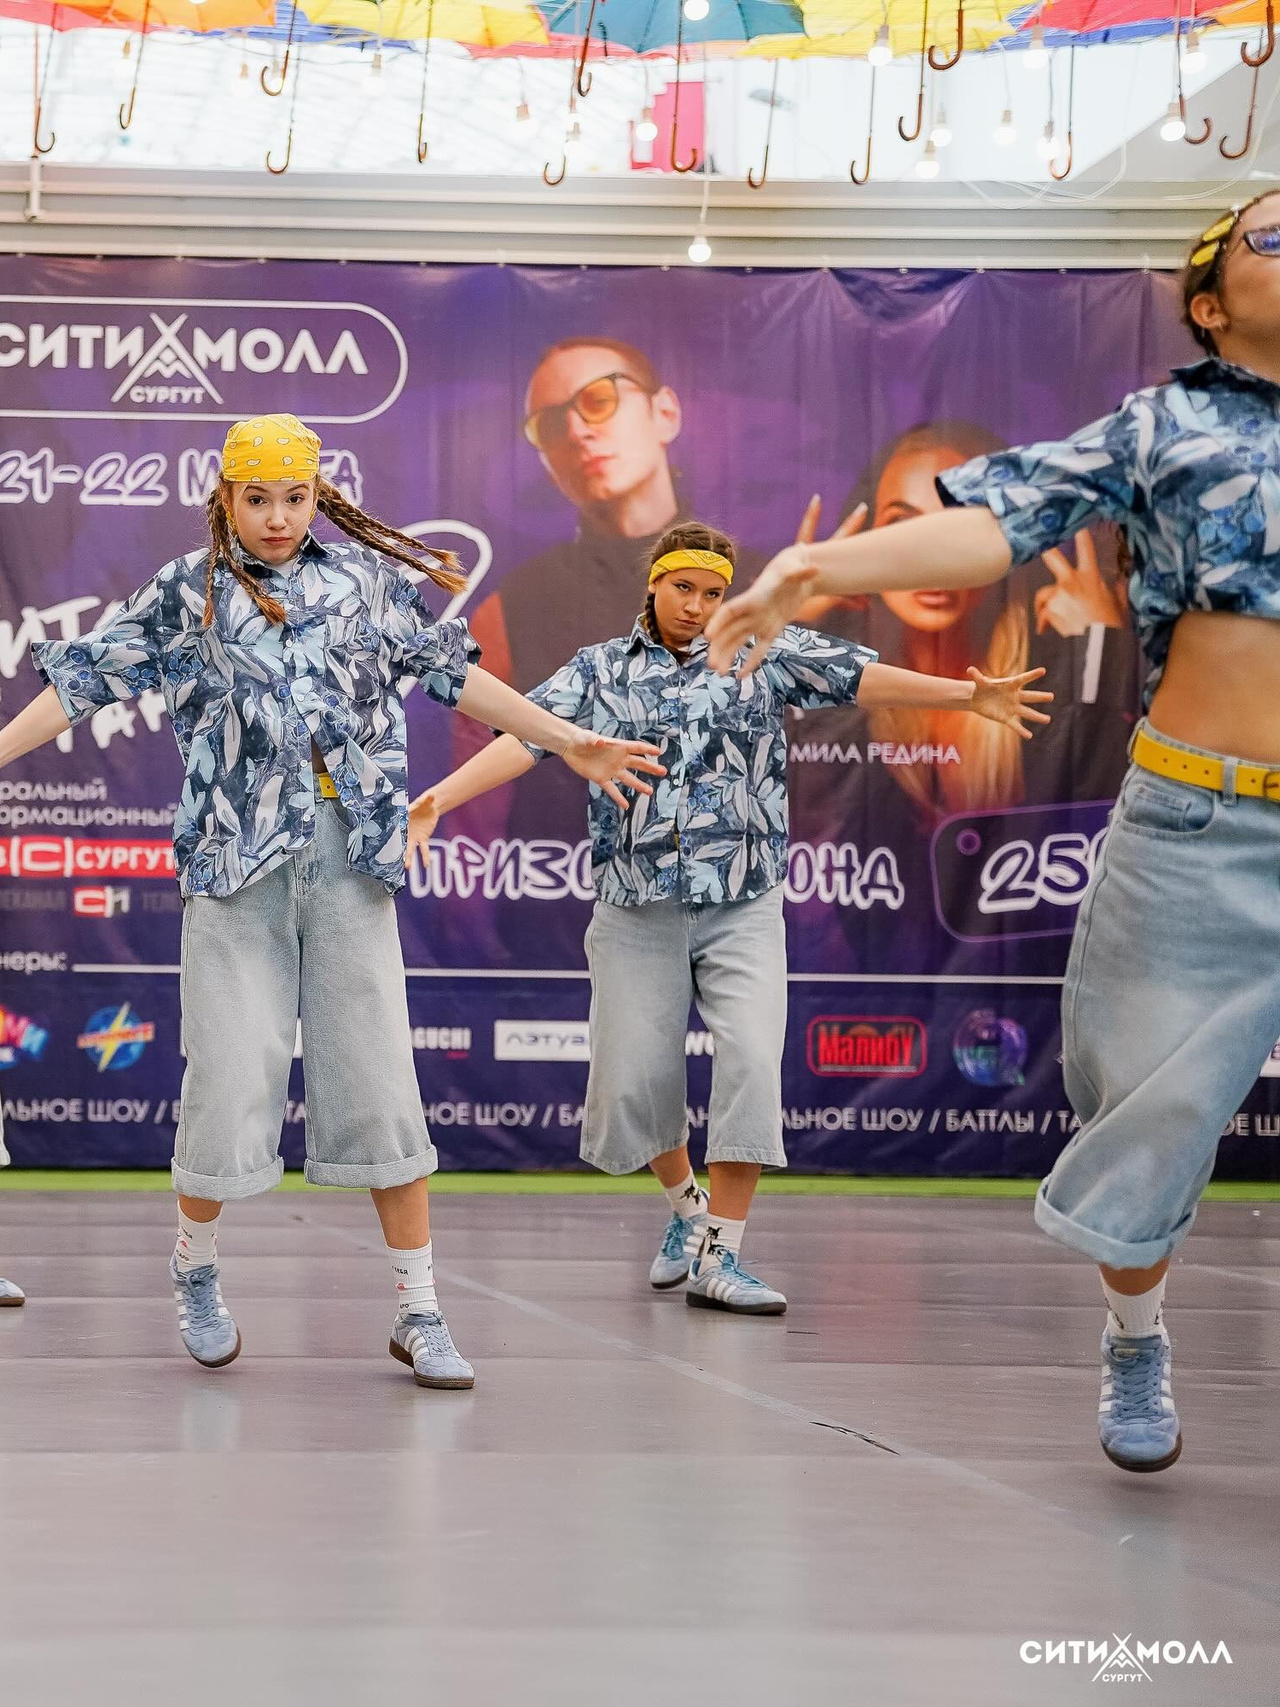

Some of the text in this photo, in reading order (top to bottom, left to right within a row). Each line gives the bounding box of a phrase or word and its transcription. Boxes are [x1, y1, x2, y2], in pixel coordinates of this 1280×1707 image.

[193, 327, 369, 375] МОЛЛ
[129, 385, 205, 403] СУРГУТ
[789, 742, 961, 766] МИЛА РЕДИНА
[76, 846, 176, 870] СУРГУТ
[410, 834, 905, 911] ПРИЗО ОНД
[87, 1098, 150, 1123] ШОУ
[474, 1102, 538, 1127] ШОУ
[861, 1107, 923, 1132] ШОУ
[946, 1108, 1035, 1133] БАТТЛЫ
